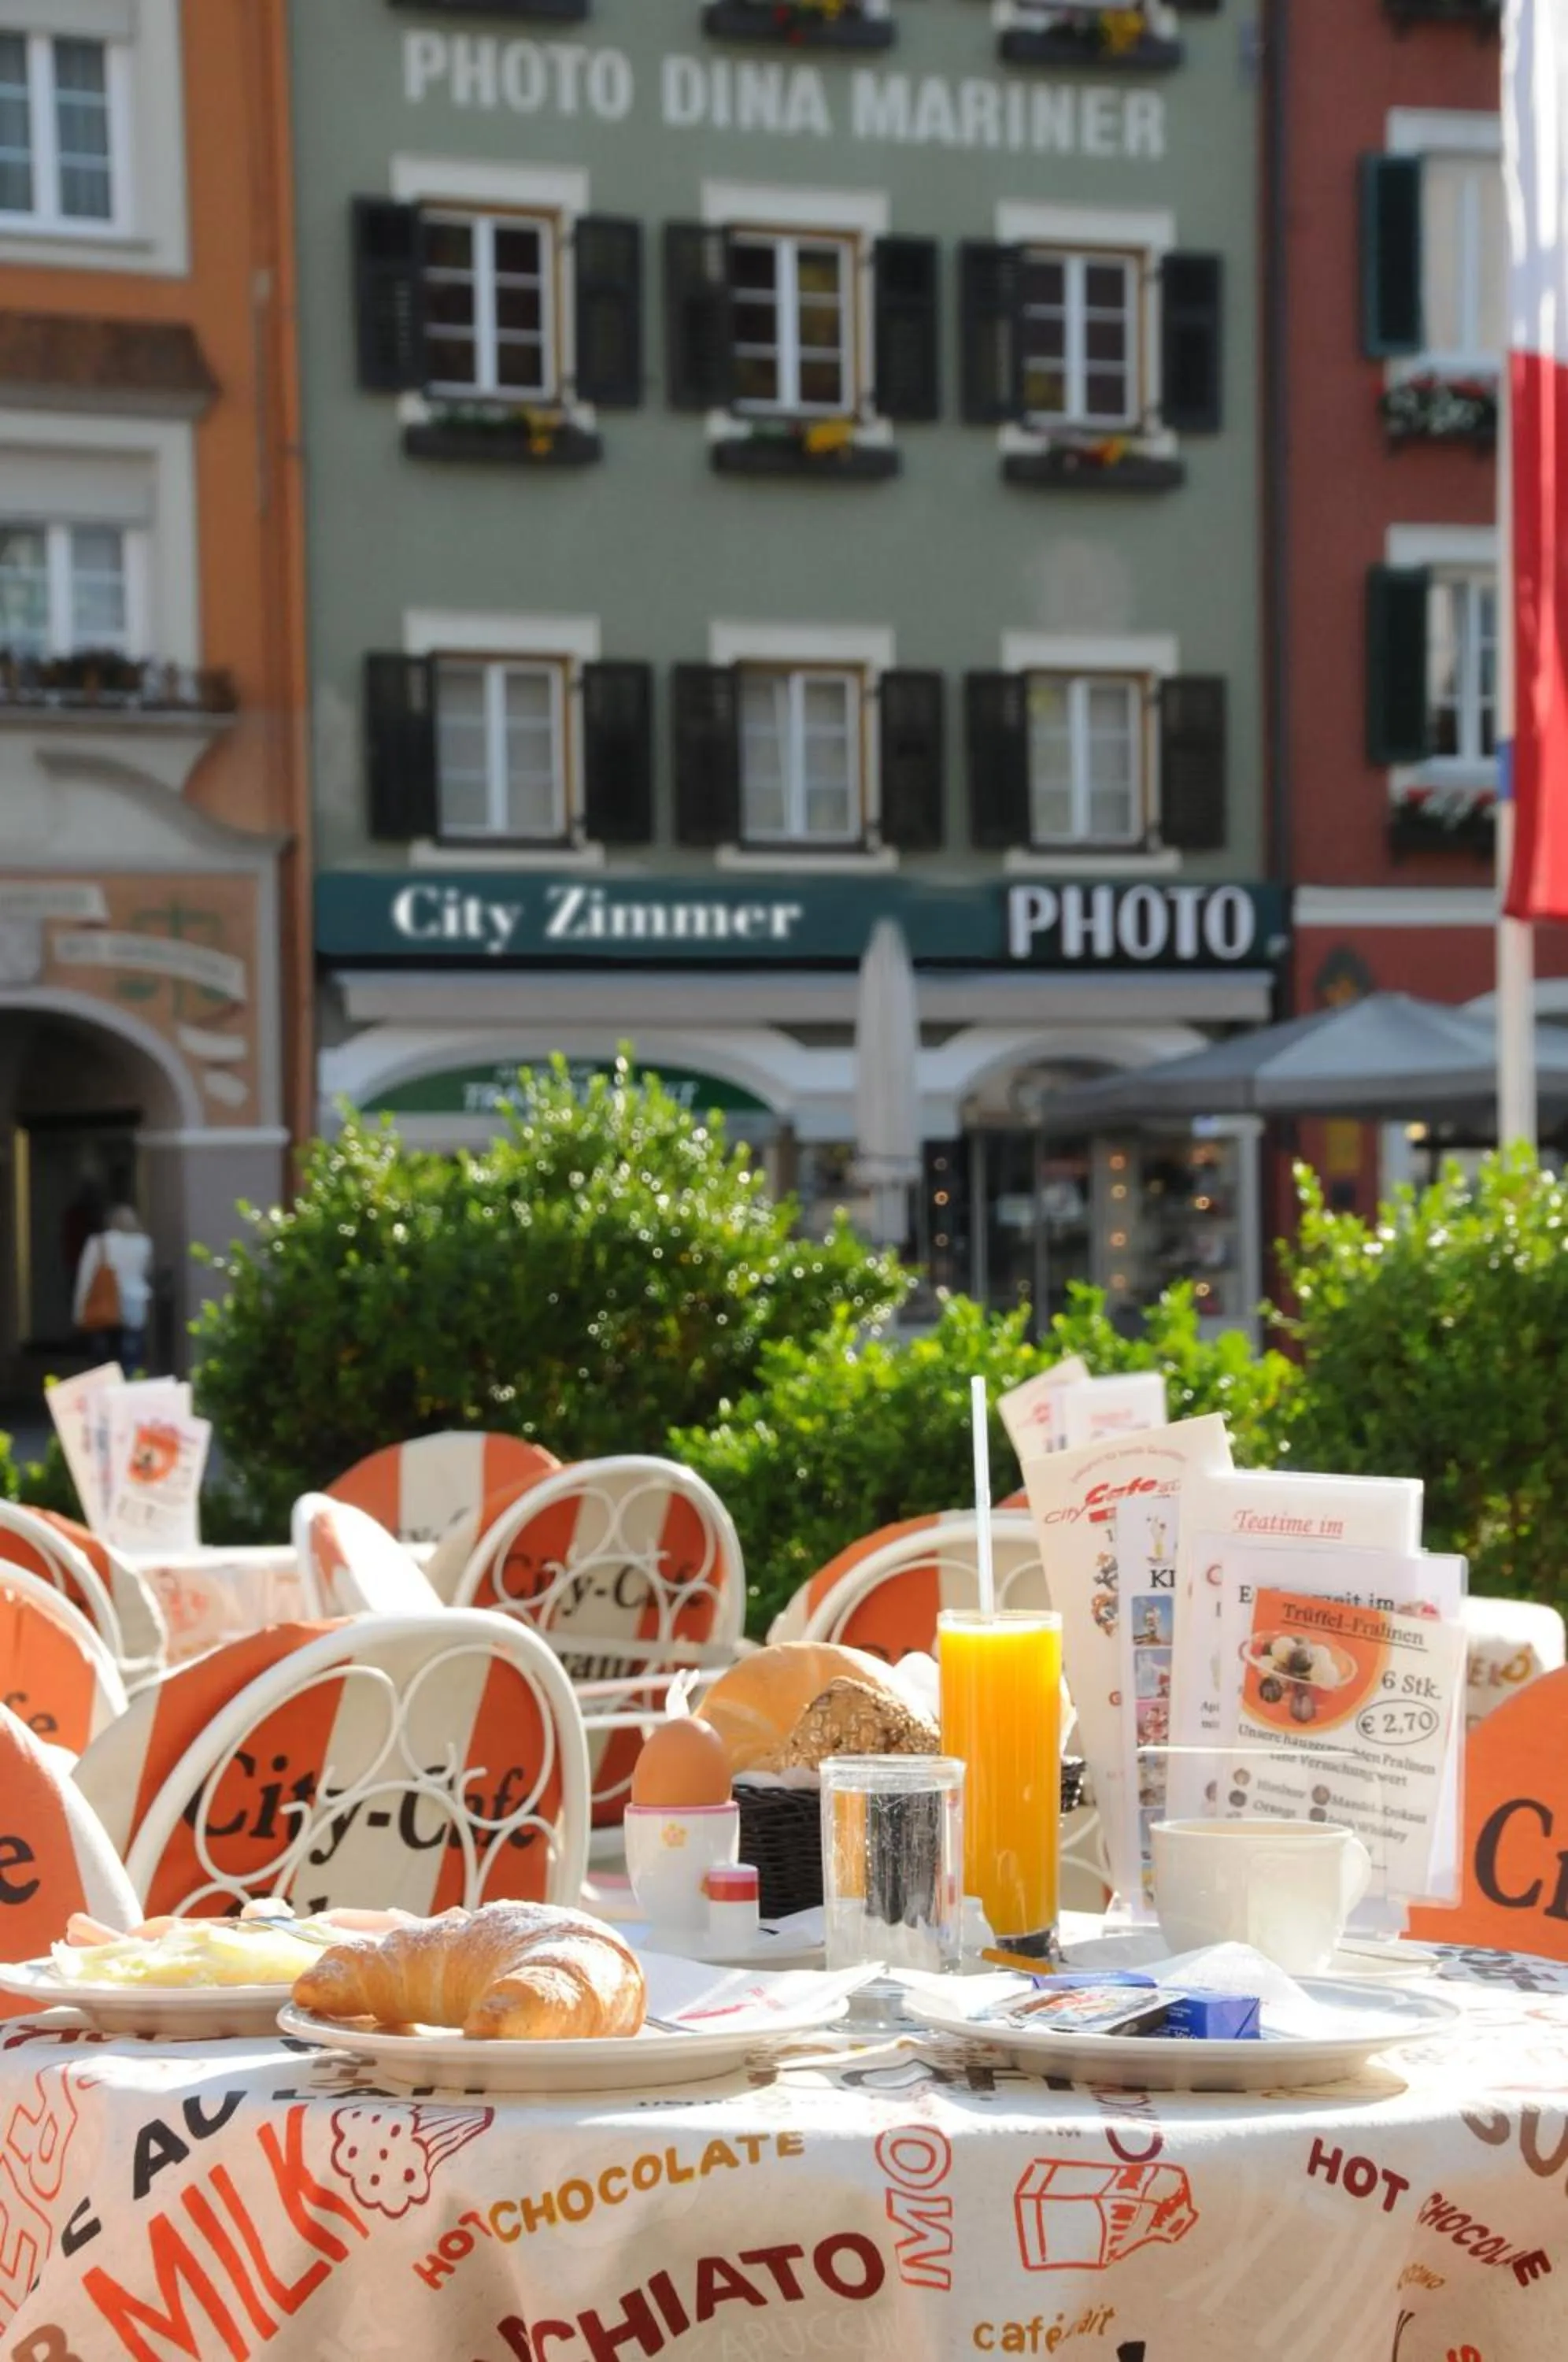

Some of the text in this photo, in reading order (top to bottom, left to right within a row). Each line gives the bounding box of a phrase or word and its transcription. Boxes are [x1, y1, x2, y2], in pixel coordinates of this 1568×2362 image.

[402, 28, 1167, 161] PHOTO DINA MARINER
[391, 884, 802, 955] City Zimmer
[1008, 883, 1256, 961] PHOTO
[1233, 1509, 1344, 1536] Teatime im
[1381, 1670, 1443, 1701] 6 Stk.
[1382, 1710, 1434, 1736] 2,70
[412, 2131, 805, 2290] HOT CHOCOLATE
[1307, 2136, 1411, 2213] HOT
[82, 2103, 370, 2362] MILK
